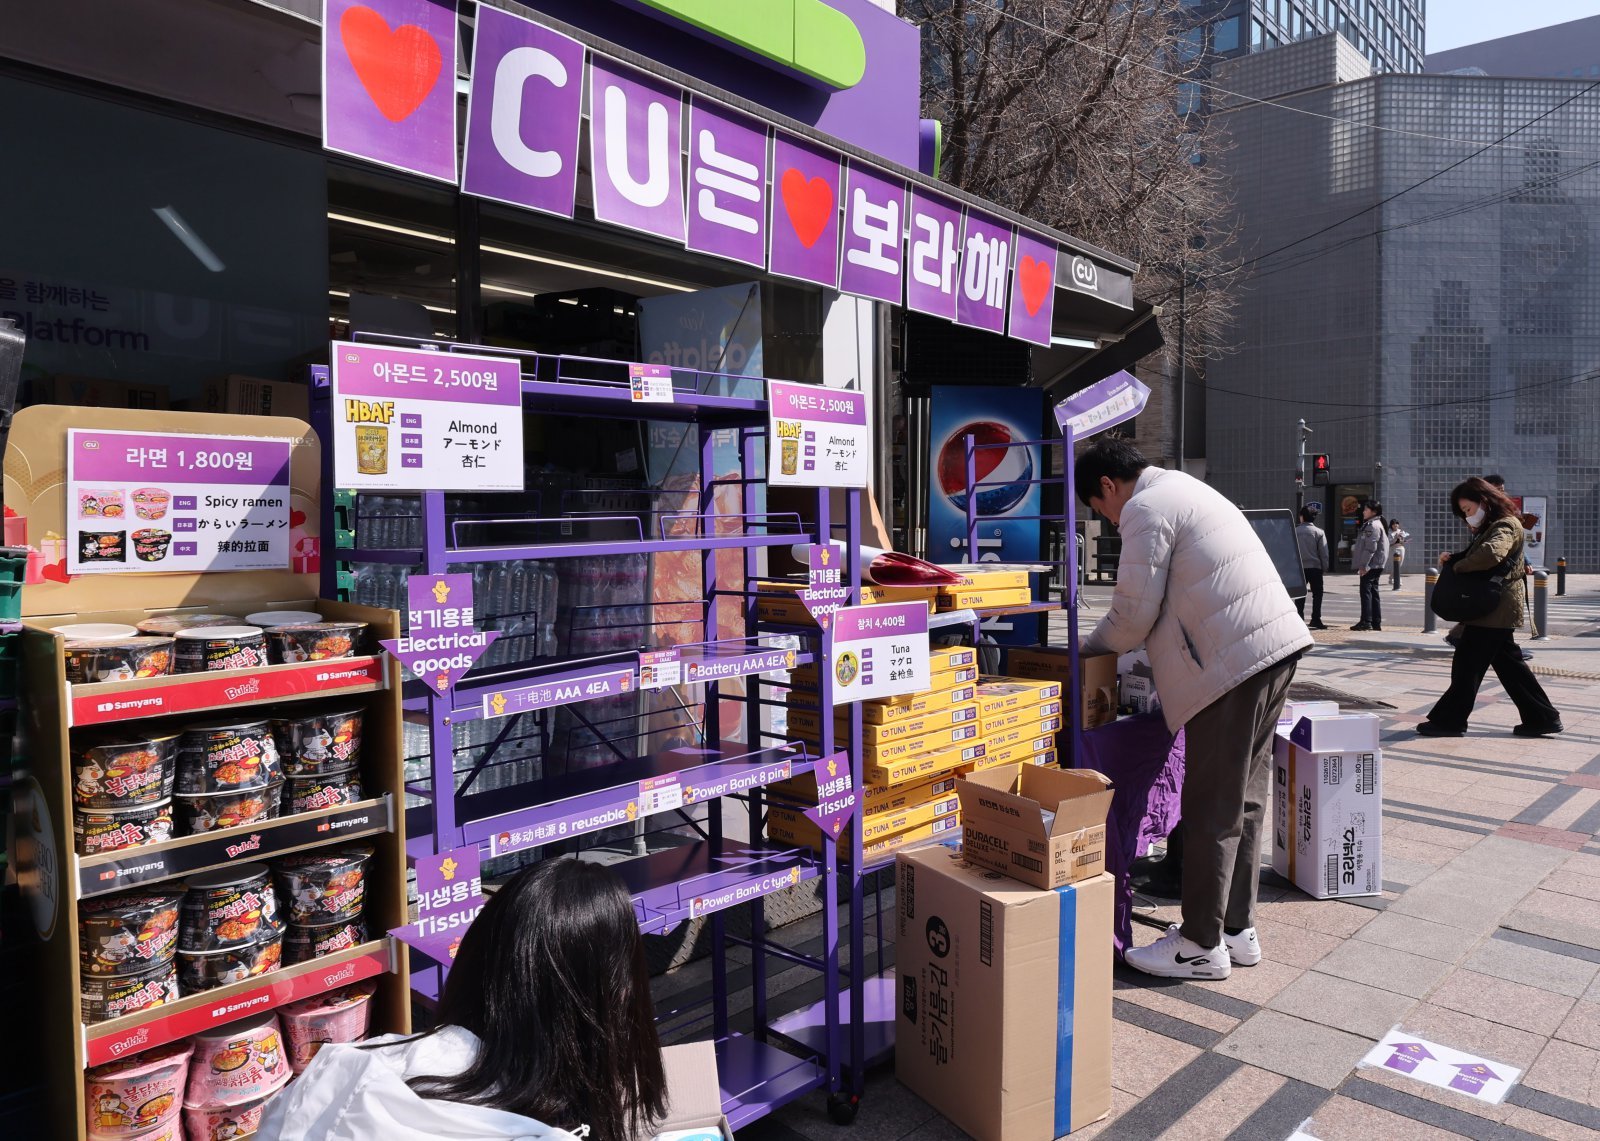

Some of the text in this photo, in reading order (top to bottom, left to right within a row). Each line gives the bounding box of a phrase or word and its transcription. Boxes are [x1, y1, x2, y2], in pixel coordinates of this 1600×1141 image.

[1076, 262, 1093, 280] CU
[24, 280, 110, 312] 함께하는
[373, 362, 498, 391] 아몬드 2,500원
[345, 399, 395, 424] HBAF
[789, 394, 854, 415] 아몬드 2,500원
[448, 420, 497, 434] Almond
[776, 421, 802, 439] HBAF
[443, 437, 502, 451] アーモンド
[829, 436, 855, 446] Almond
[126, 447, 253, 471] 라면 1,800원
[826, 448, 857, 459] アーモンド
[461, 455, 486, 468] 杏仁
[834, 461, 848, 471] 杏仁
[205, 495, 283, 509] Spicy ramen
[217, 540, 270, 553] 辣的拉面
[809, 569, 841, 584] 전기용품
[804, 587, 846, 600] Electrical
[869, 590, 885, 599] TUNA
[969, 596, 983, 605] TUNA
[812, 602, 840, 618] goods
[409, 608, 473, 630] 전기용품
[857, 615, 905, 630] 참치 4,400원
[397, 632, 487, 653] Electrical
[891, 644, 910, 654] Tuna
[207, 646, 258, 671] 불닭볶음면
[413, 653, 473, 676] goods
[697, 654, 786, 678] Battery AAA 4EA
[890, 657, 912, 666] マグロ
[329, 668, 367, 680] Samyang
[890, 668, 914, 681] 金枪鱼
[555, 685, 581, 700] AAA
[586, 681, 610, 695] 4EA
[114, 697, 163, 710] Samyang
[894, 705, 911, 716] TUNA
[990, 701, 1004, 710] TUNA
[890, 725, 907, 736] TUNA
[992, 718, 1005, 728] TUNA
[992, 736, 1006, 745] TUNA
[208, 737, 261, 762] 불닭볶음면
[890, 745, 907, 755] TUNA
[984, 756, 998, 766] TUNA
[900, 766, 917, 776] TUNA
[105, 771, 162, 797] 불닭볶음면
[692, 783, 728, 801] Power
[730, 774, 757, 791] Bank
[759, 772, 766, 784] 8
[768, 767, 785, 786] pin
[817, 775, 853, 800] 위생용품
[873, 785, 888, 795] TUNA
[816, 793, 855, 818] Tissue
[873, 802, 889, 812] TUNA
[1303, 785, 1312, 841] 크리넥스
[331, 815, 368, 830] Samyang
[510, 808, 626, 846] 移动电源 8 reusable
[873, 823, 889, 834] TUNA
[86, 823, 143, 847] 불닭볶음면
[966, 827, 1008, 852] DURACELL
[965, 838, 989, 853] DELUXE
[1055, 844, 1084, 859] DCELL
[1356, 840, 1363, 853] 티슈
[1343, 826, 1355, 885] 크리넥스
[116, 860, 164, 877] Samyang
[417, 876, 482, 913] 위생용품
[702, 873, 792, 910] Power Bank C type
[208, 892, 261, 919] 불닭볶음면
[108, 981, 164, 1011] 불닭볶음면
[227, 994, 269, 1013] Samyang
[905, 984, 915, 1012] 양반
[928, 962, 948, 1066] 들기름김
